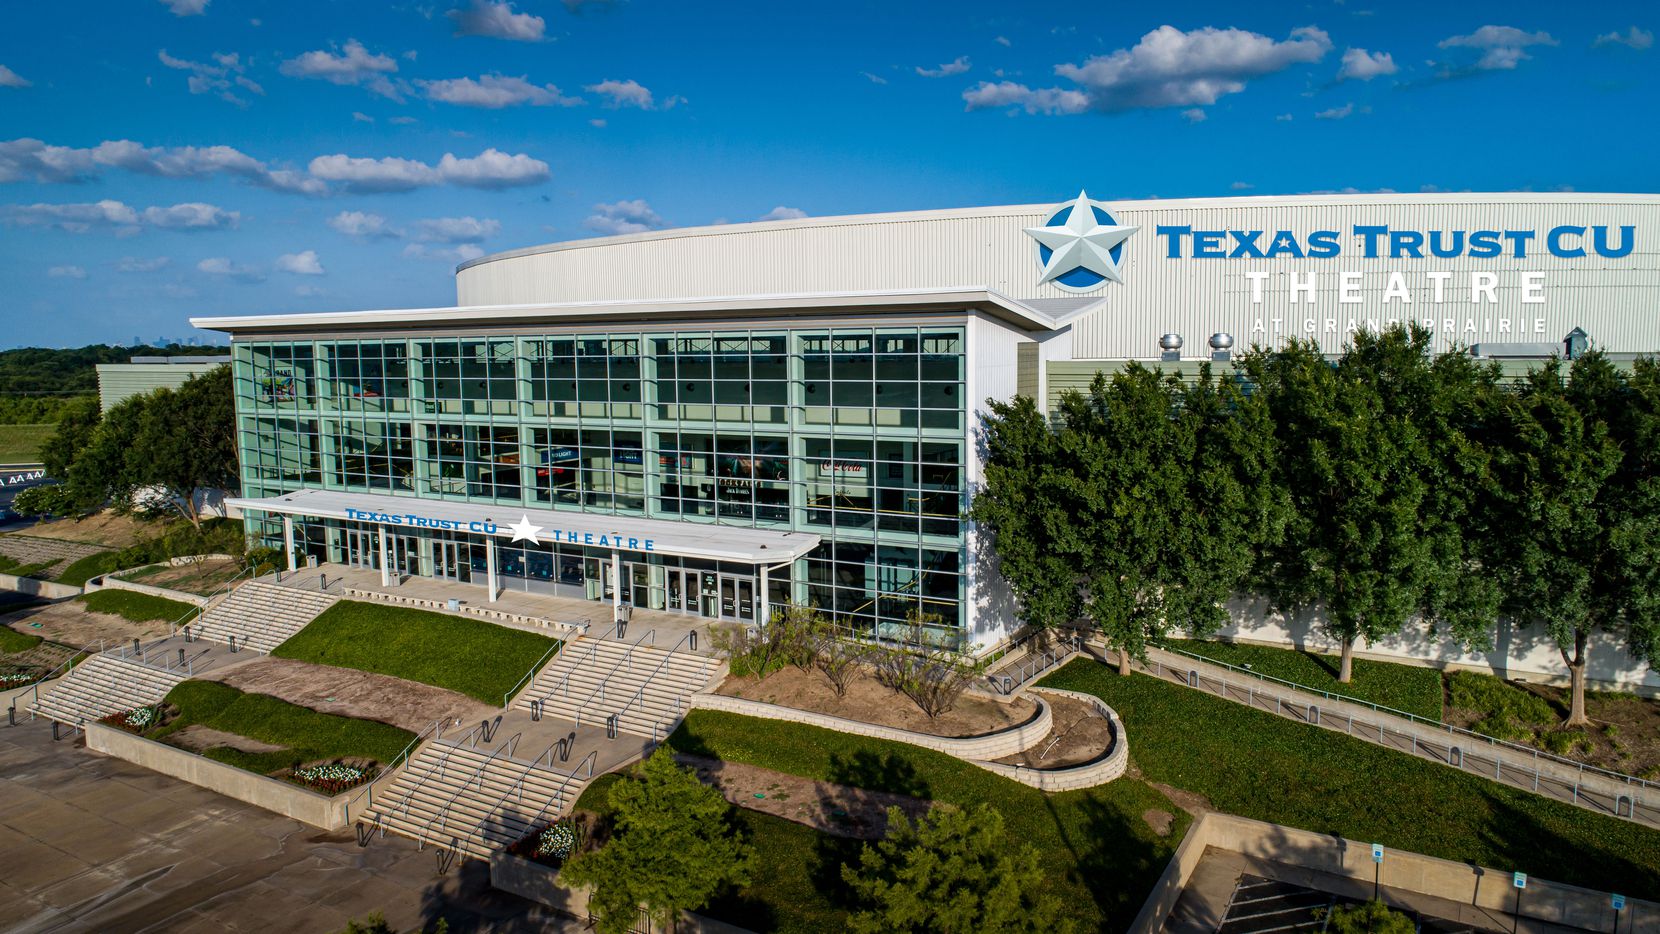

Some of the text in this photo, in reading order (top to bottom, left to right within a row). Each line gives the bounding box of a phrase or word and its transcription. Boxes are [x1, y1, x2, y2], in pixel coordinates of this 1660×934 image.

[1155, 224, 1636, 259] TEXAS TRUST CU
[1245, 271, 1546, 303] THEATRE
[1251, 318, 1282, 333] AT
[1423, 318, 1545, 333] PRAIRIE
[345, 507, 497, 535] TEXAS TRUST CU
[553, 529, 655, 552] THEATRE
